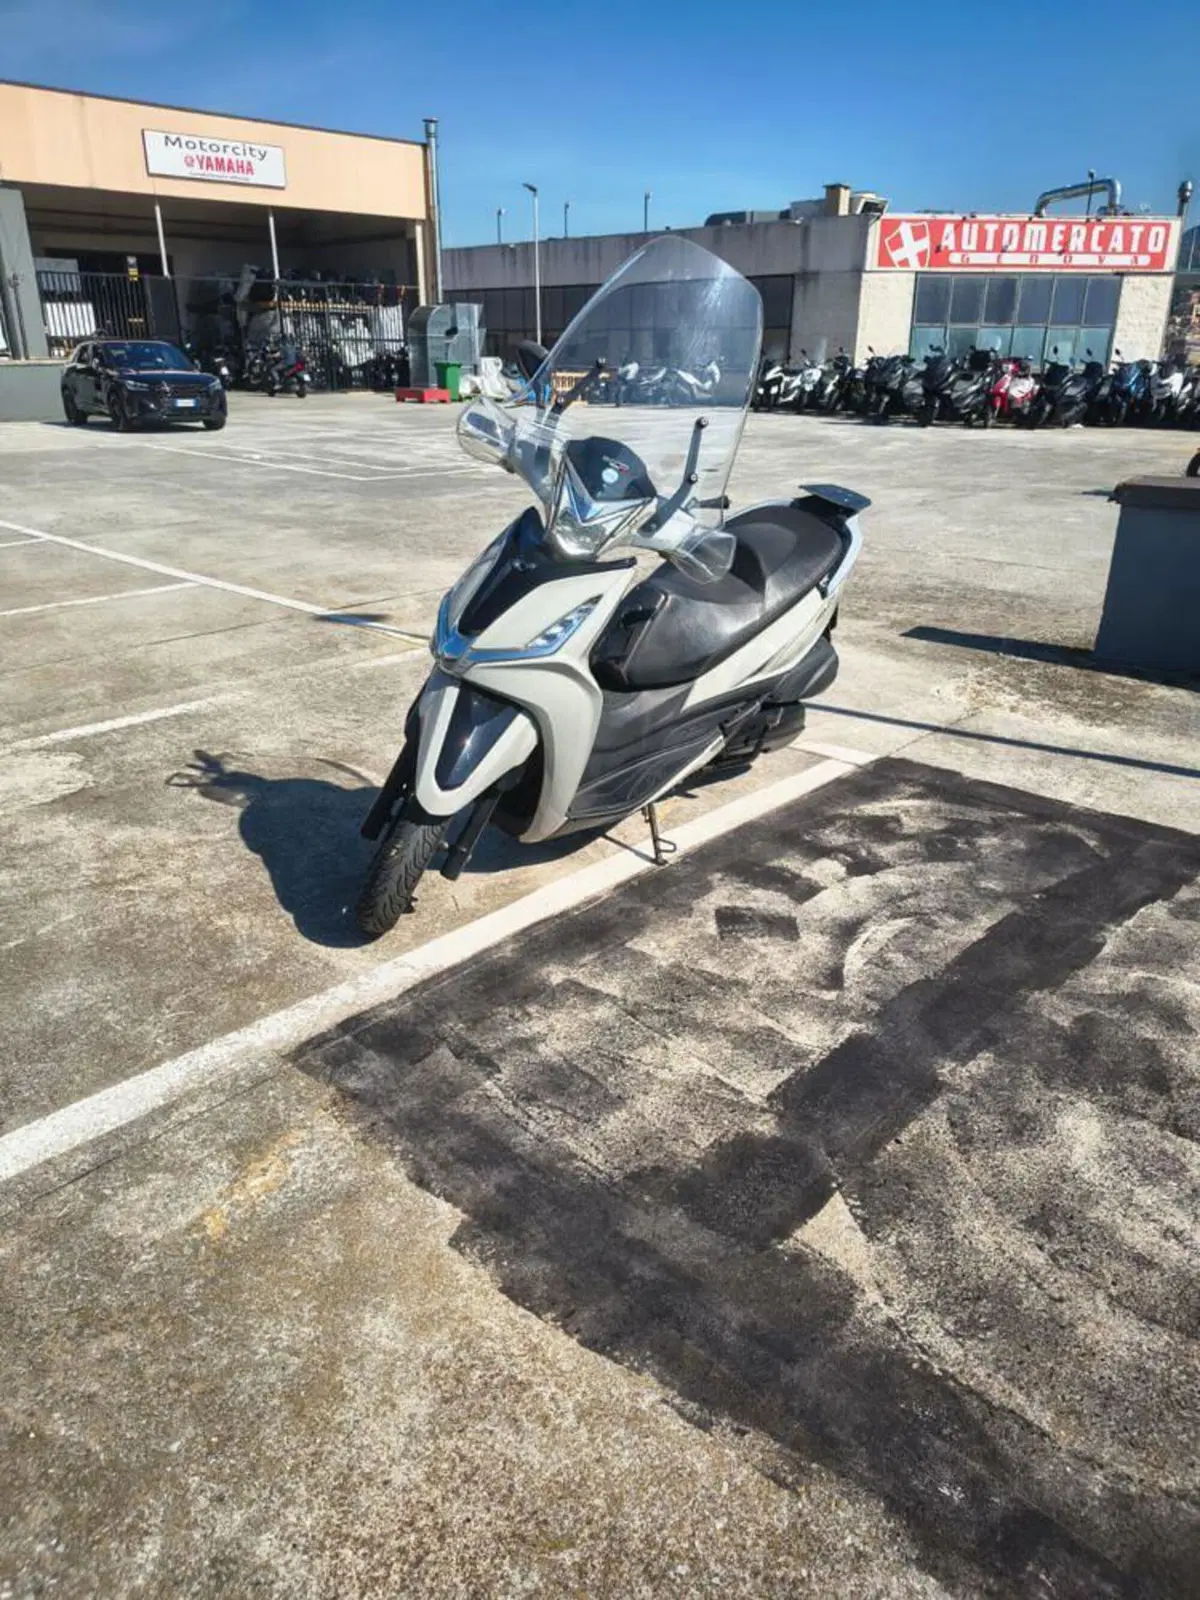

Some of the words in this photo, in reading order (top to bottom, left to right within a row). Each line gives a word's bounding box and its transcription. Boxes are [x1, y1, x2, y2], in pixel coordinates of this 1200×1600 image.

[164, 135, 267, 160] Motorcity
[196, 155, 254, 176] YAMAHA
[940, 222, 1166, 253] AUTOMERCATO
